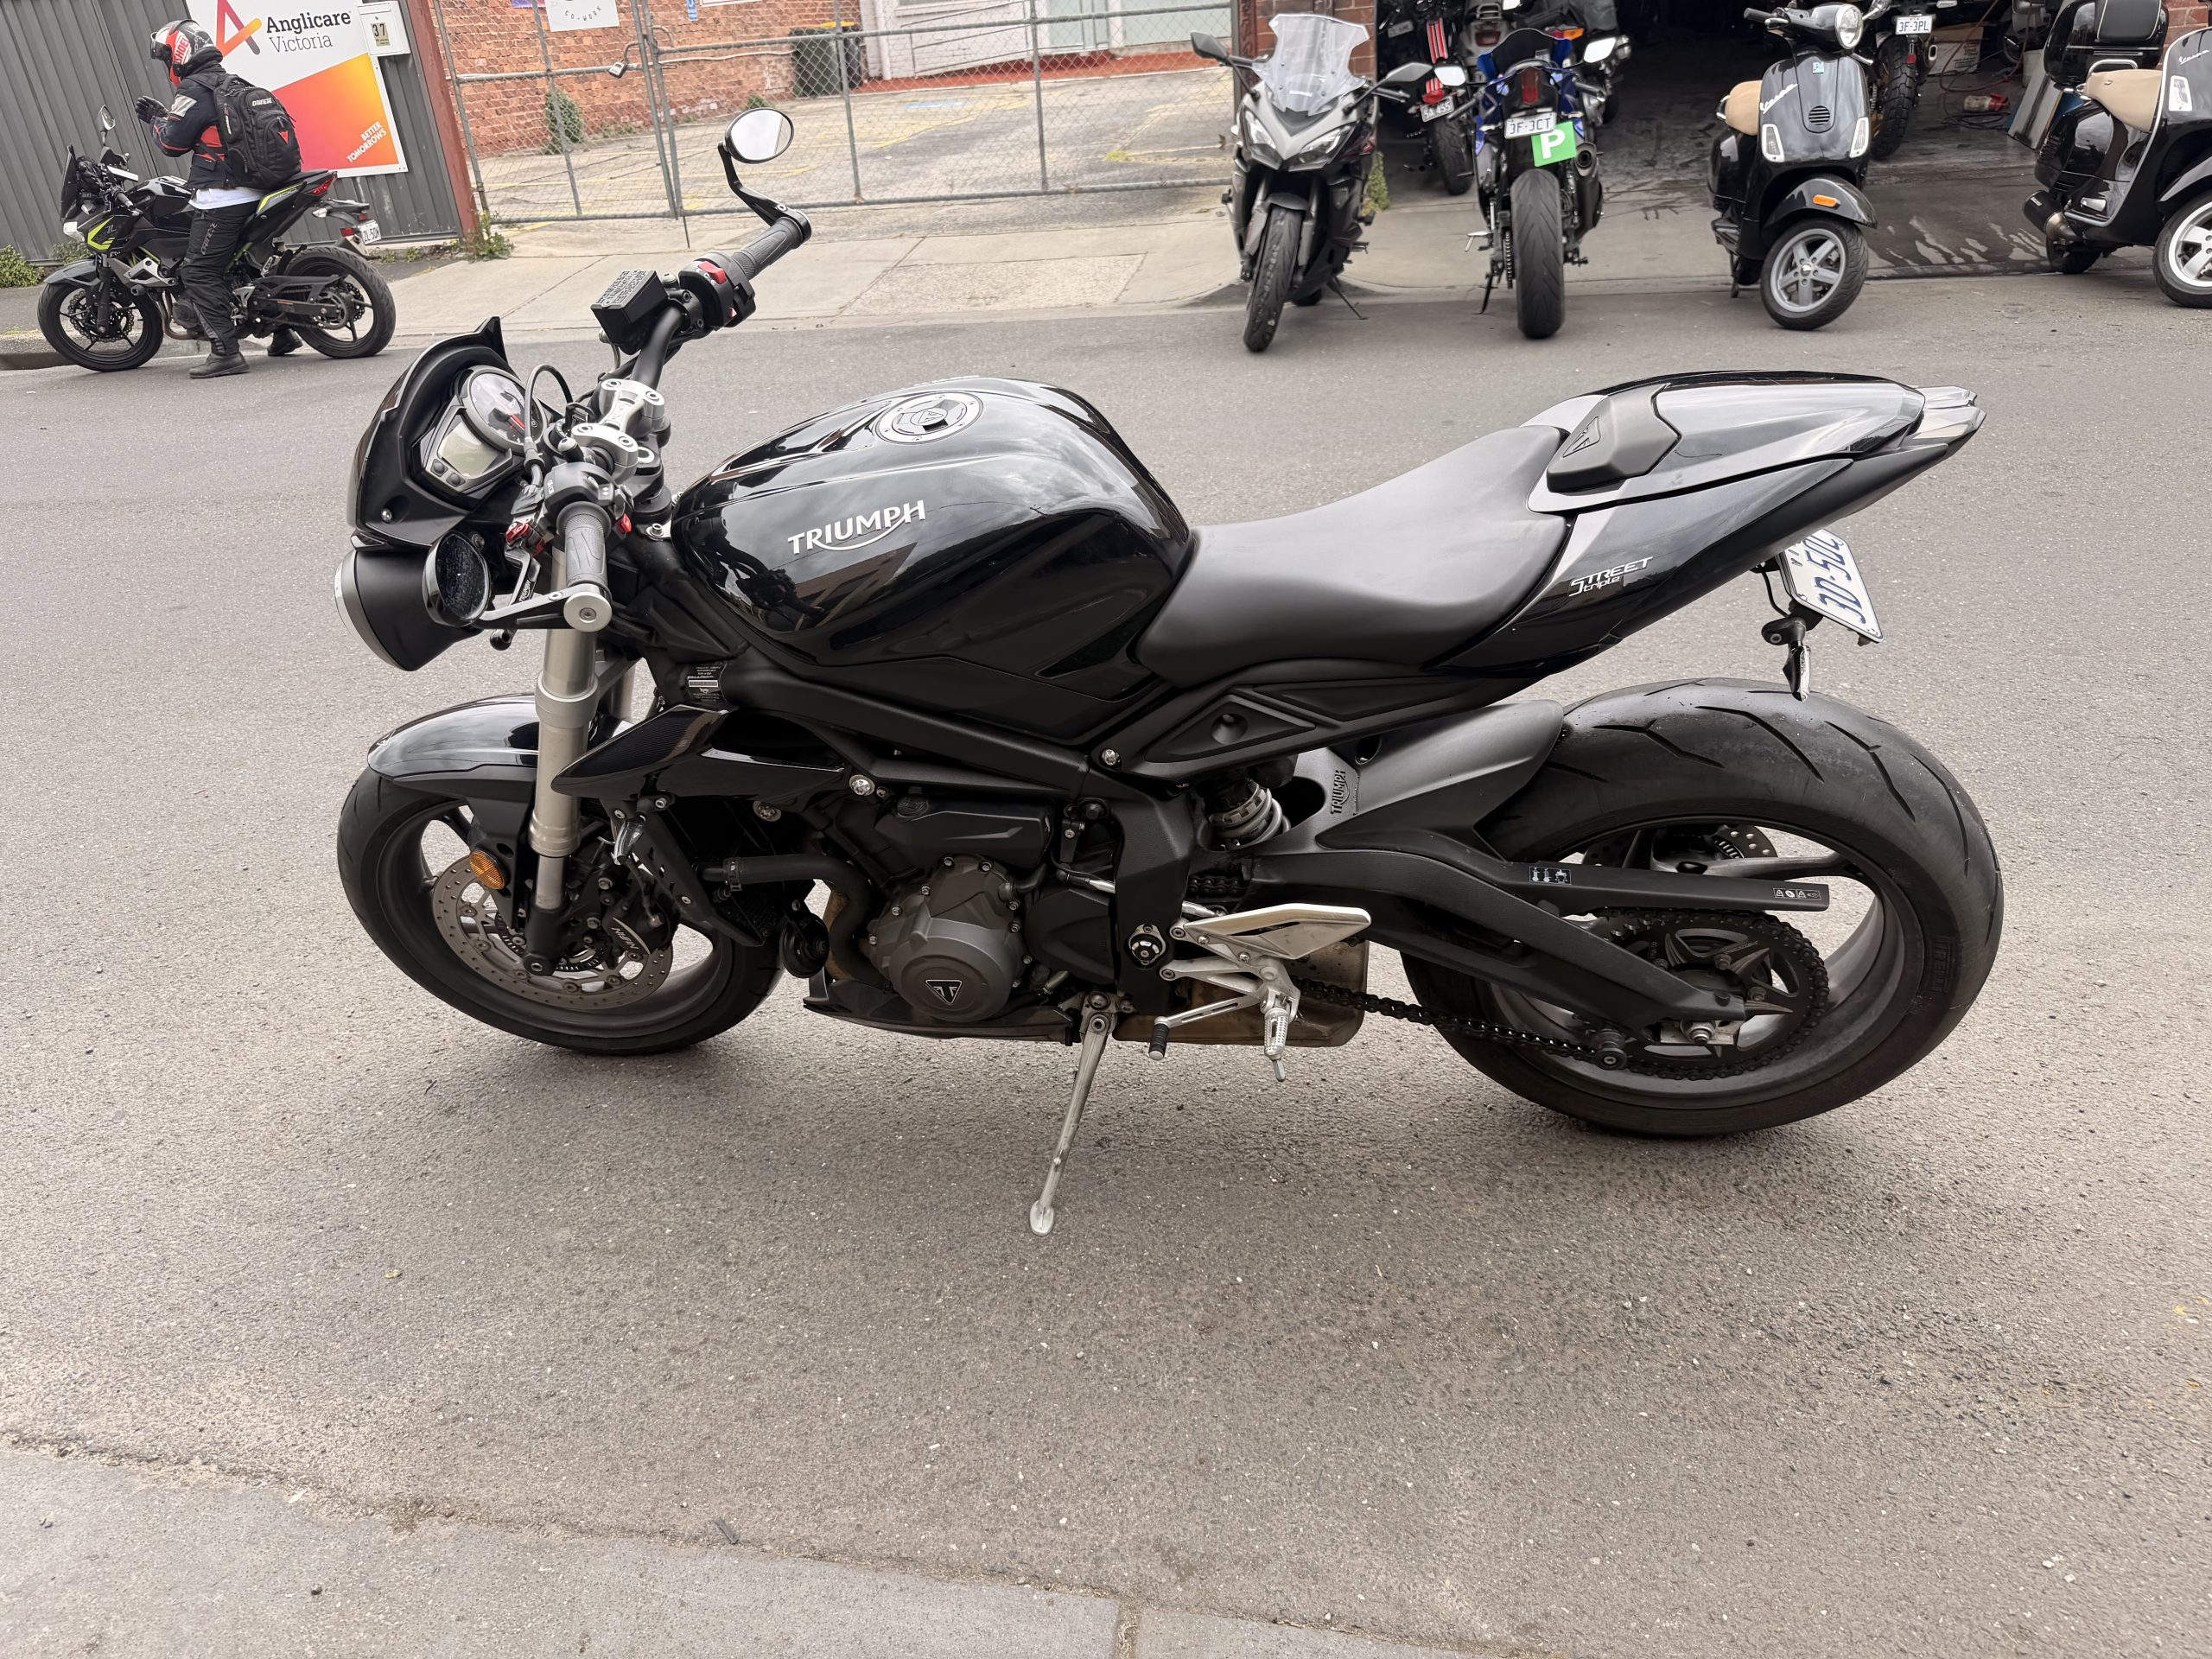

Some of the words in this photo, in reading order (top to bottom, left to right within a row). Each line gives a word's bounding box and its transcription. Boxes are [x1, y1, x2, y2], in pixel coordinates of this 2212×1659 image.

[266, 11, 351, 35] Anglicare
[564, 5, 601, 22] CO-WORK
[372, 23, 385, 37] 37
[1898, 20, 1930, 33] 3F-3PL
[174, 37, 190, 63] SHOEI
[269, 32, 334, 54] Victoria
[2178, 49, 2210, 65] Vespa
[1760, 83, 1798, 114] Vespa
[360, 121, 383, 142] BETTER
[346, 127, 387, 162] TOMORROWS
[1540, 129, 1566, 160] P
[787, 499, 926, 556] TRIUMPH
[1568, 556, 1654, 597] STREET
[1583, 575, 1621, 591] triple
[1330, 769, 1350, 815] TRIUMPH
[611, 927, 639, 950] NISSIN
